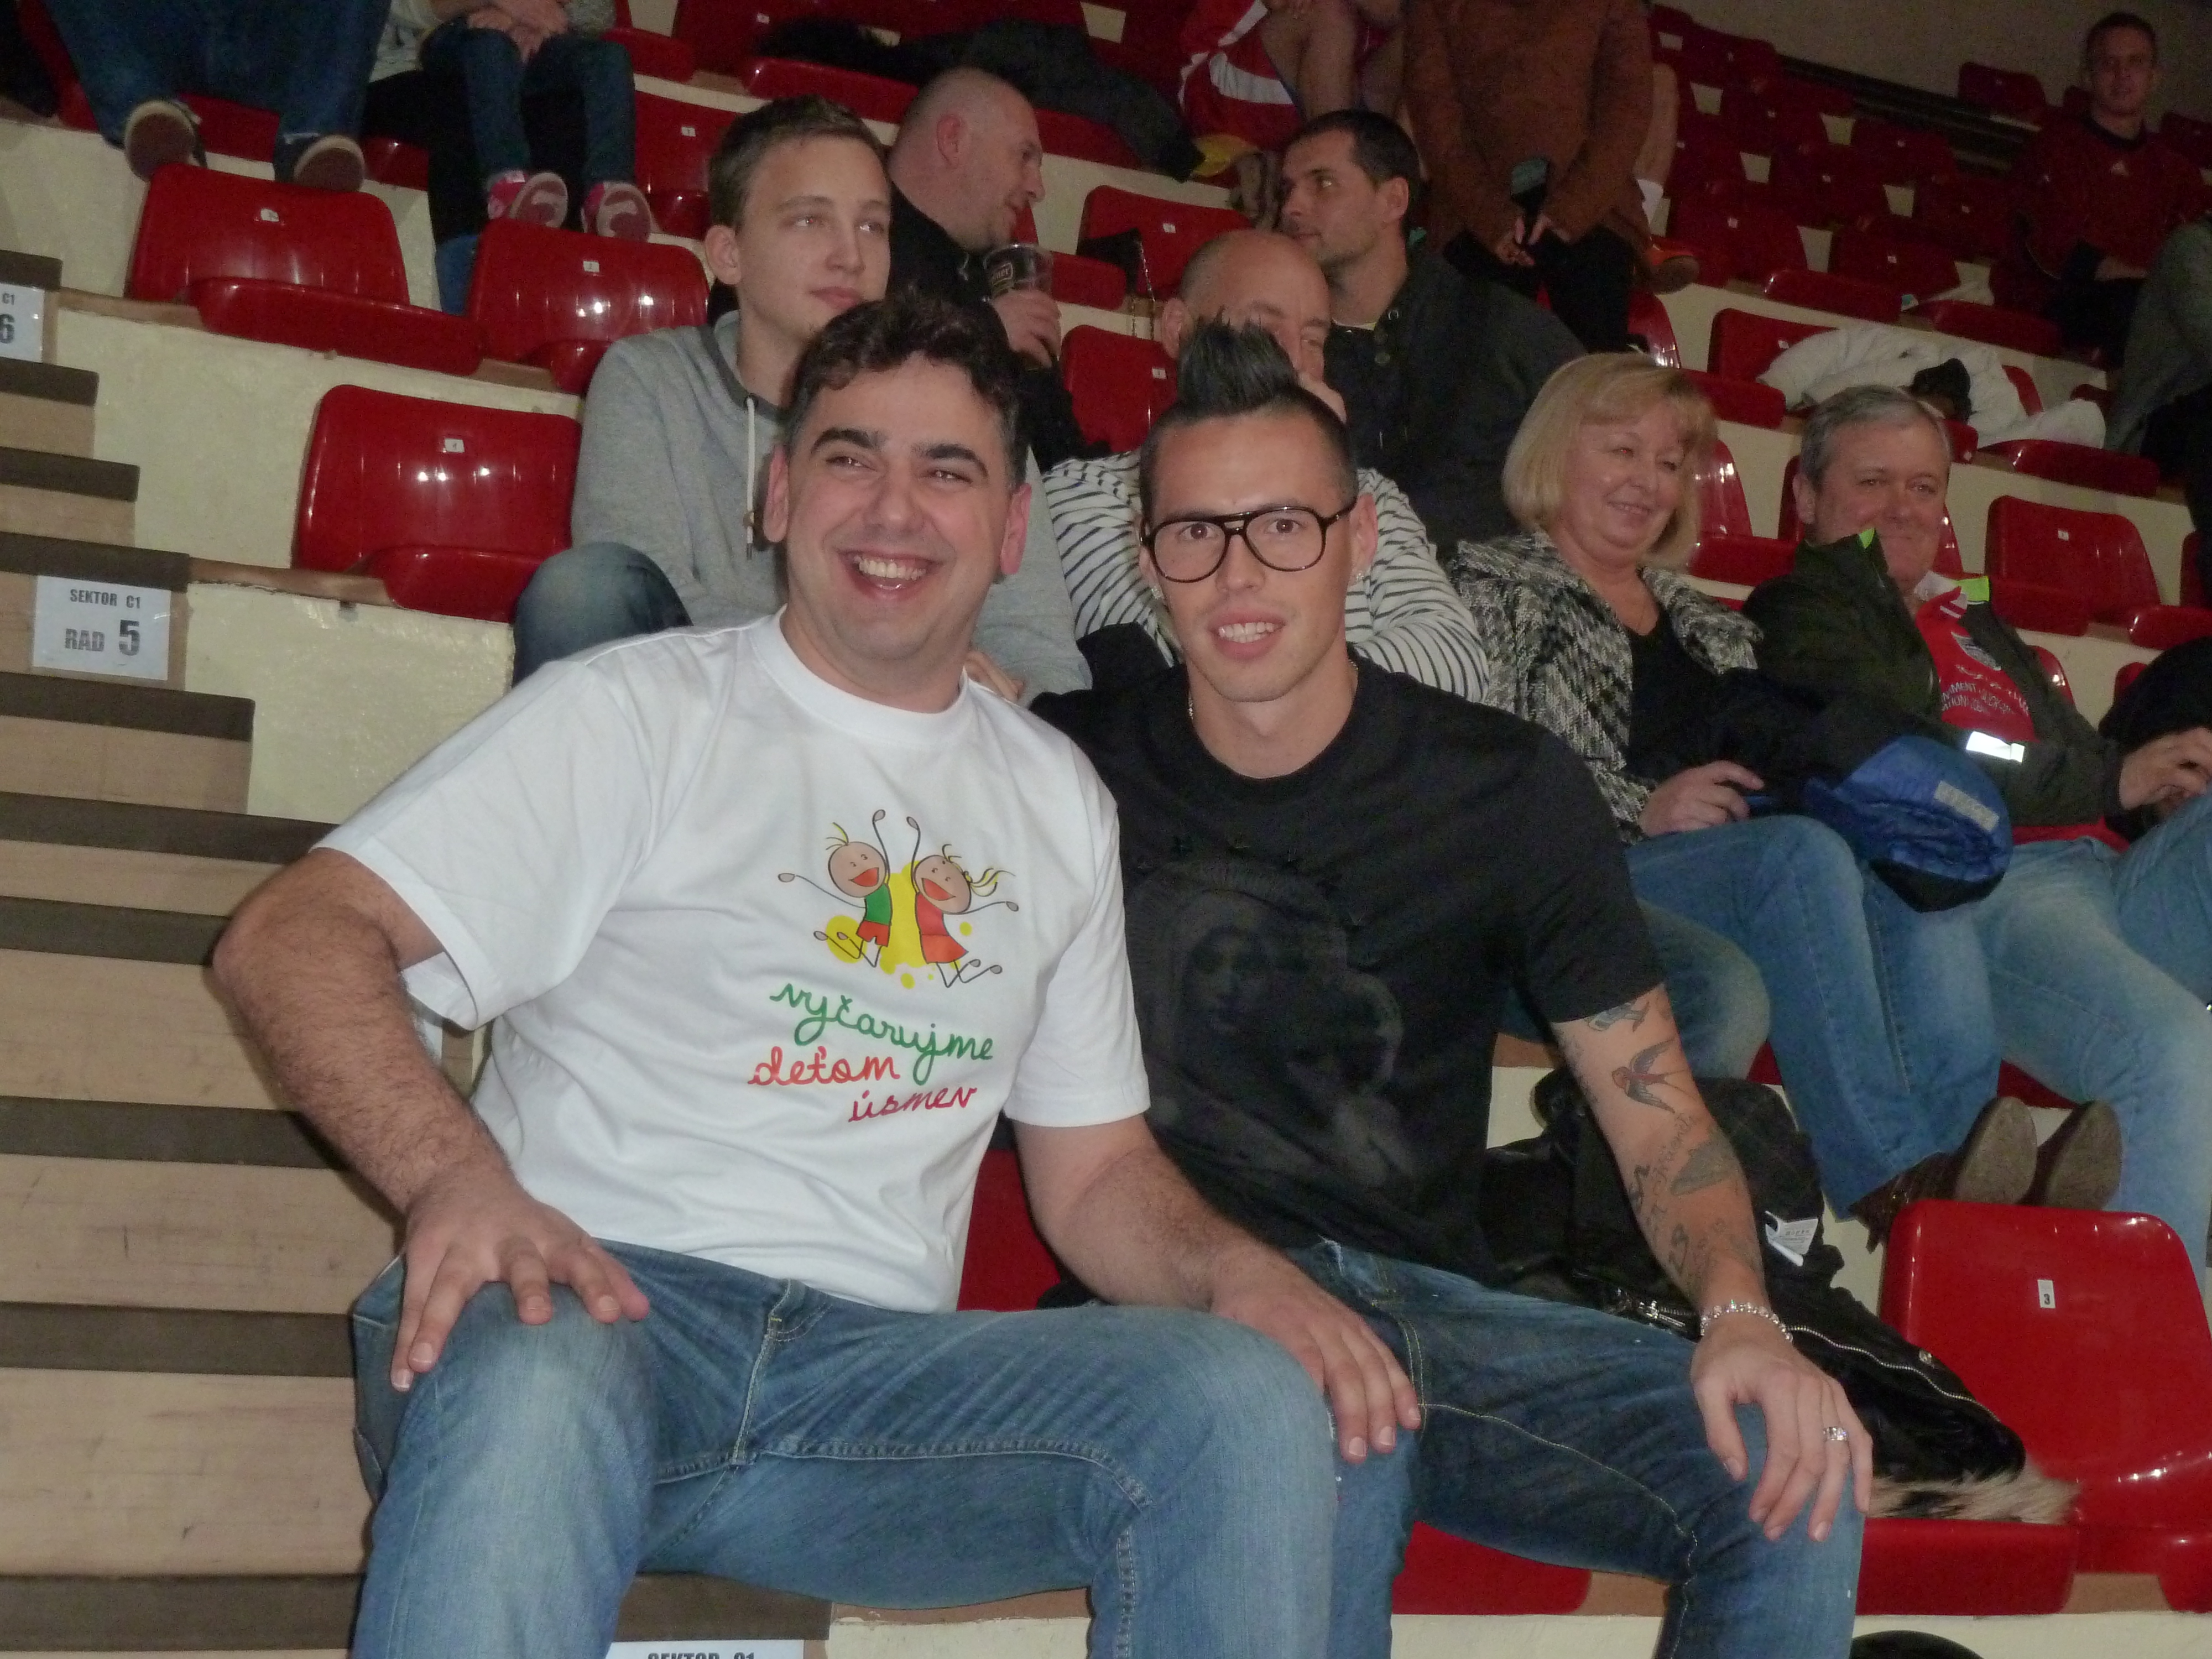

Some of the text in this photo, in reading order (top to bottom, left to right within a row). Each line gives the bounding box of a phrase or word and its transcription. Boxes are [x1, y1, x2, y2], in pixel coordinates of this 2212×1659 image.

[2, 293, 15, 305] C1
[0, 312, 15, 344] 6
[70, 588, 141, 609] SEKTOR C1
[65, 619, 140, 656] RAD 5
[770, 983, 993, 1086] vyčarujme
[748, 1046, 900, 1086] deťom
[848, 1087, 978, 1123] úsmev
[2043, 1293, 2051, 1305] 3
